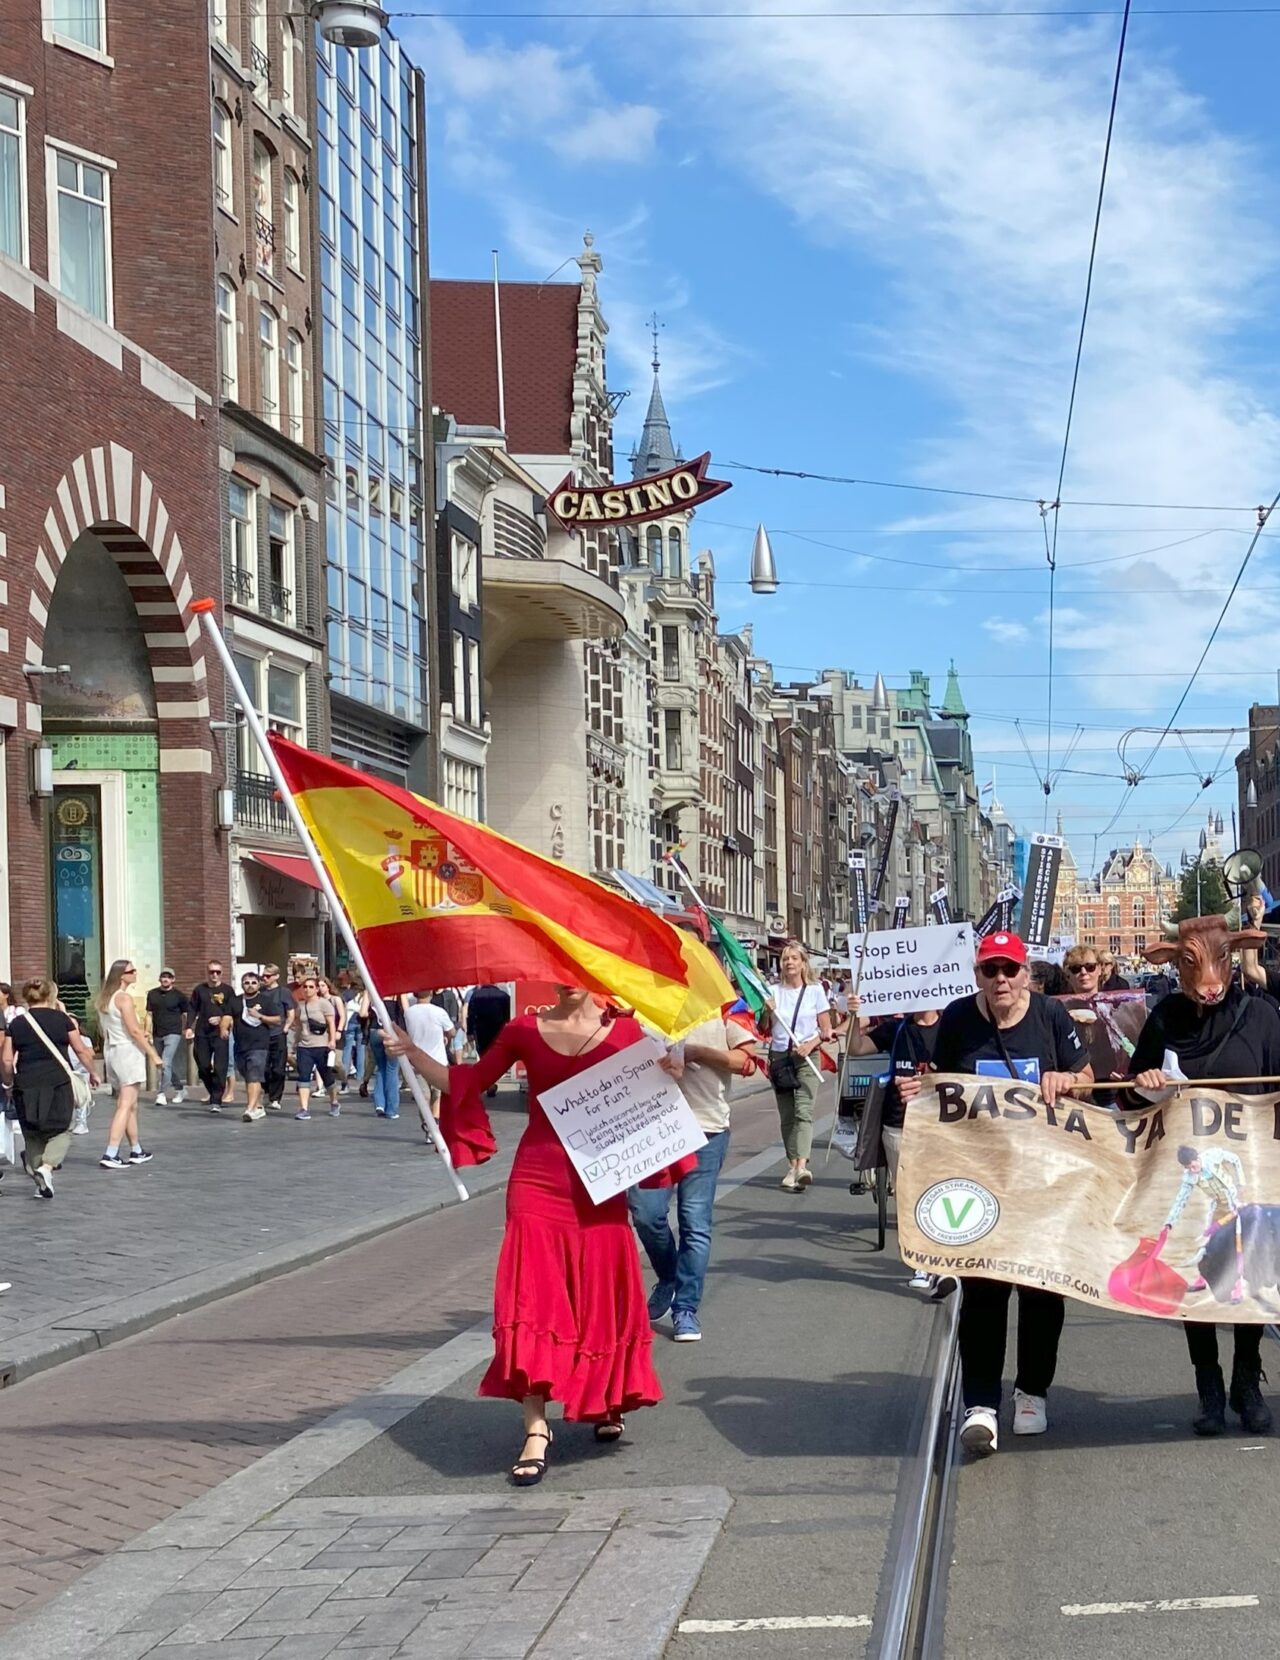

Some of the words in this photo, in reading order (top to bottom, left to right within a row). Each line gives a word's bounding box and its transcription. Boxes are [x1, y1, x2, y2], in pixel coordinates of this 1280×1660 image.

[554, 471, 699, 520] CASINO
[1028, 848, 1046, 942] STIERENVECHTEN
[1035, 848, 1053, 942] AFSCHAFFEN!
[854, 945, 891, 960] Stop
[896, 939, 917, 955] EU
[857, 963, 928, 982] subsidies
[933, 961, 960, 974] aan
[859, 982, 974, 1005] stierenvechten
[553, 1091, 590, 1115] What
[585, 1089, 599, 1099] to
[599, 1080, 612, 1092] do
[613, 1074, 623, 1085] in
[622, 1058, 655, 1080] Spain
[584, 1103, 602, 1116] for
[603, 1085, 631, 1107] fun?
[589, 1127, 614, 1144] being
[595, 1132, 625, 1152] slowly
[661, 1103, 678, 1117] out
[935, 1081, 1093, 1141] BASTA
[1114, 1108, 1166, 1154] YA
[1190, 1098, 1248, 1141] DE
[602, 1135, 655, 1172] Dance
[657, 1119, 682, 1139] the
[924, 1187, 944, 1206] VEGAN
[941, 1197, 976, 1229] V
[903, 1246, 1100, 1300] WWW.VEGANSTREAKER.COM
